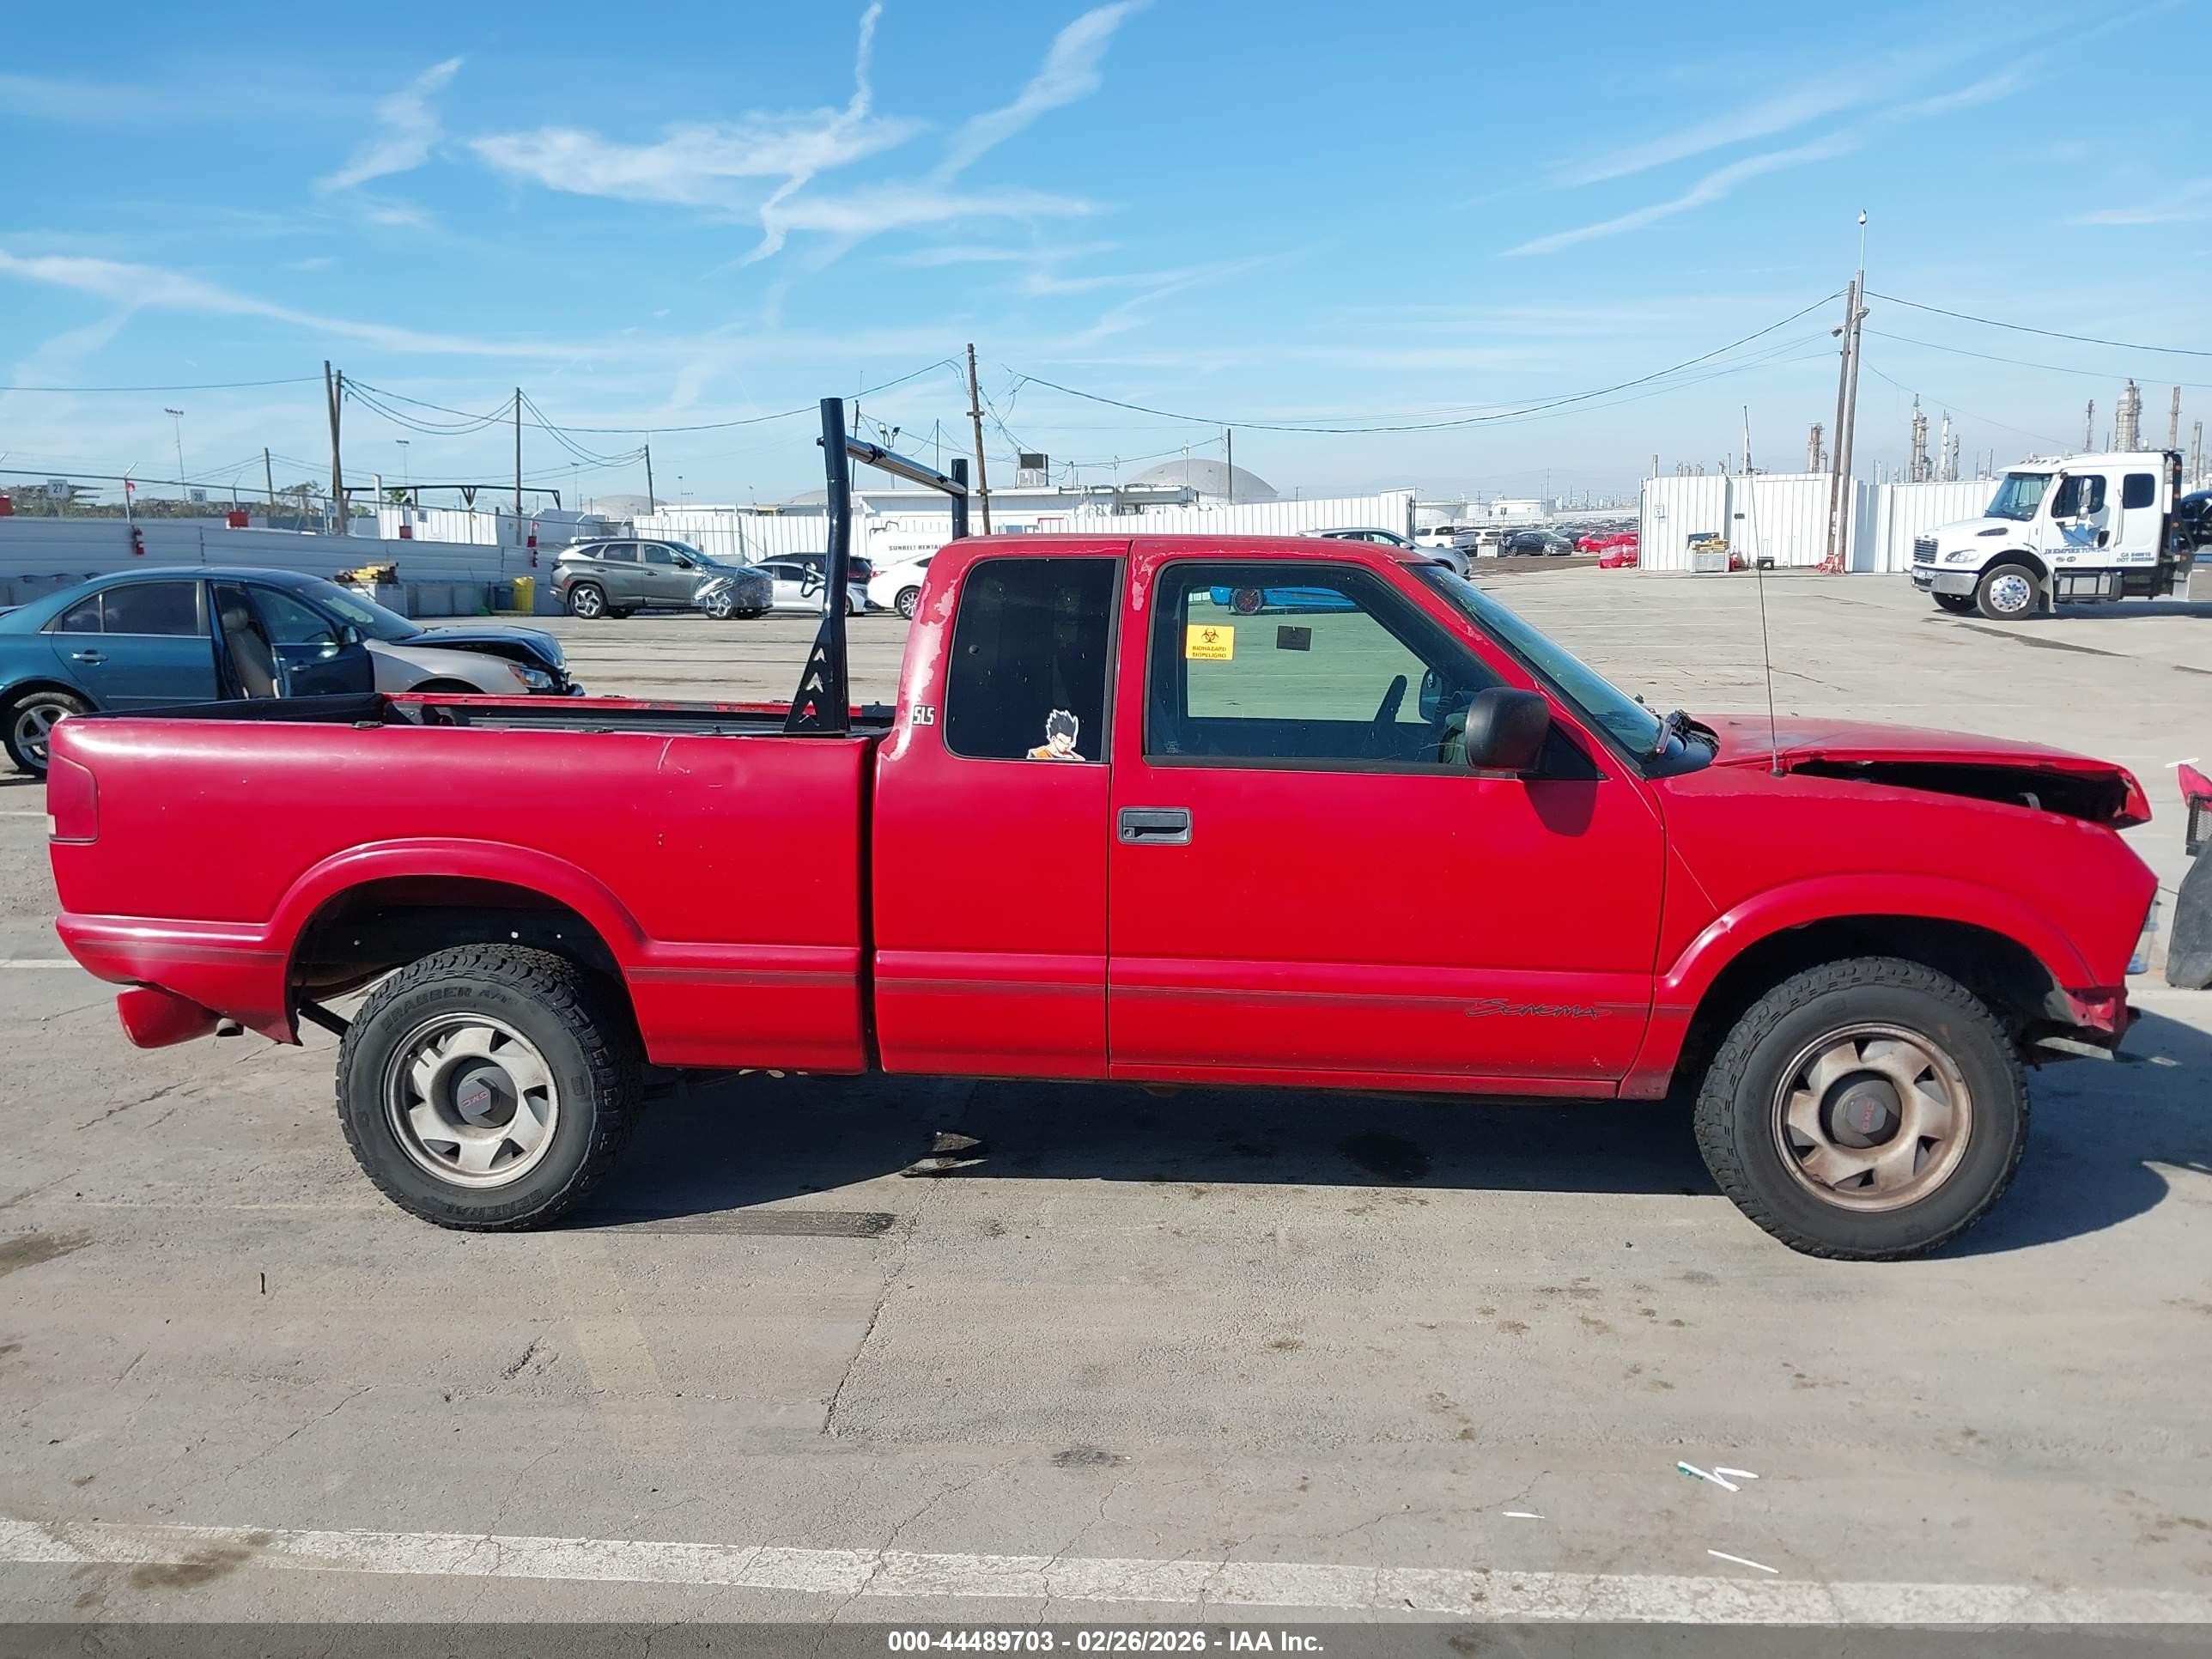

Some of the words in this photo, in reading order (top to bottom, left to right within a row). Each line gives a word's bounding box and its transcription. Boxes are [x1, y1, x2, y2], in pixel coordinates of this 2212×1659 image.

[52, 483, 64, 494] 27
[913, 706, 935, 726] SLS
[461, 1091, 489, 1107] GMC
[1862, 1098, 1875, 1131] GMC
